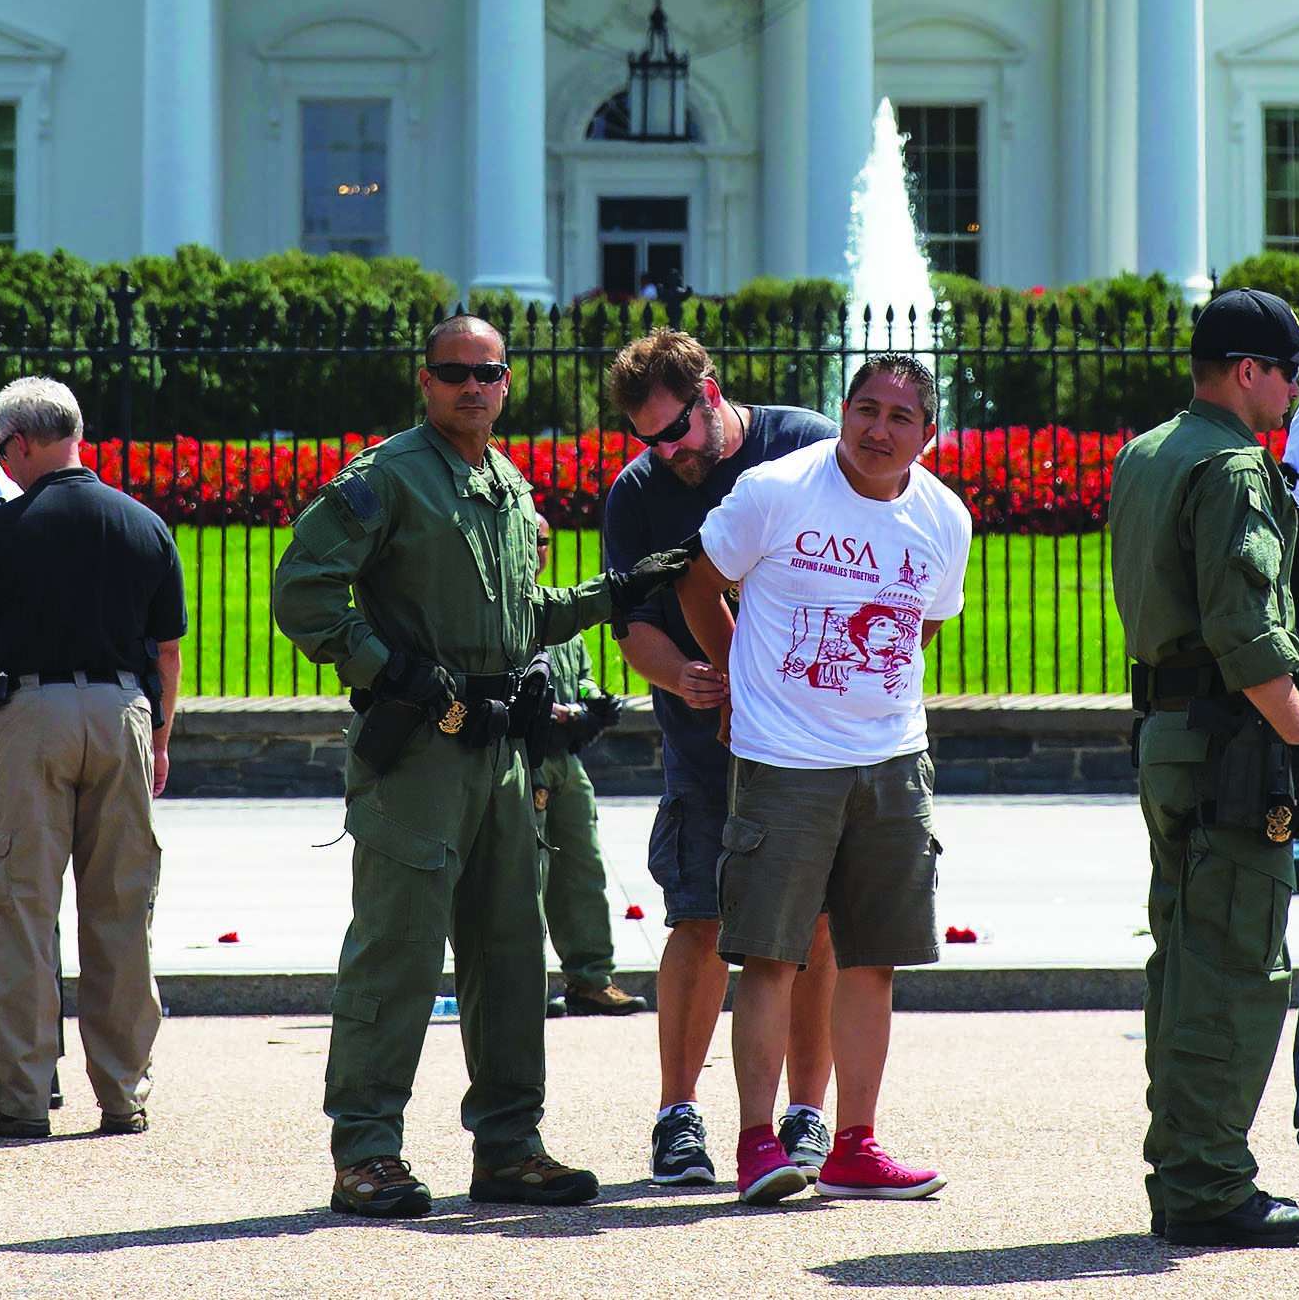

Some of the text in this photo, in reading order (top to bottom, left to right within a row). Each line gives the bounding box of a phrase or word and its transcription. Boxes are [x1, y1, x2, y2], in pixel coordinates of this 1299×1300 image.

[795, 530, 880, 570] CASA
[790, 557, 880, 584] KEEPING FAMILIES TOGETHER
